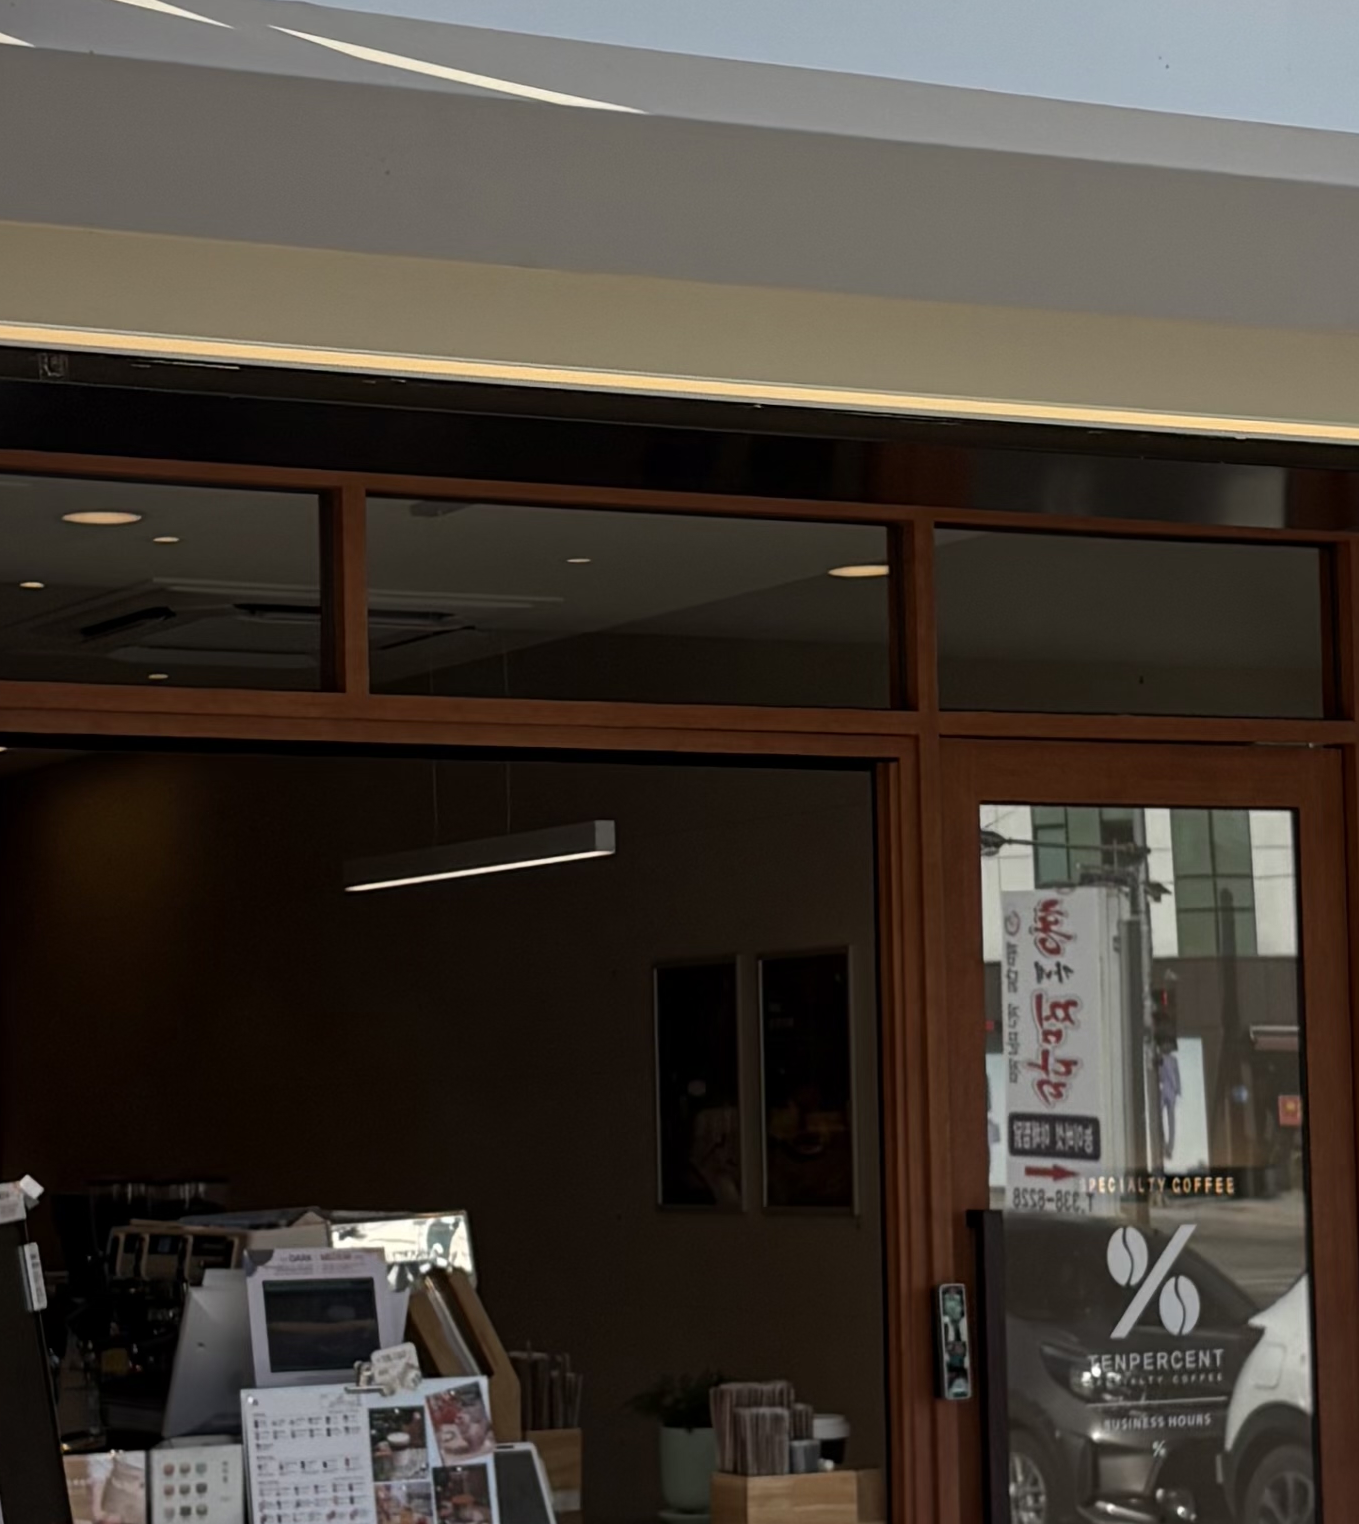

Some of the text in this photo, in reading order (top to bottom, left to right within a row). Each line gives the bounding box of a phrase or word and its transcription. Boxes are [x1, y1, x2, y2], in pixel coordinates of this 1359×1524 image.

[1171, 1176, 1236, 1195] COFFEE
[1089, 1348, 1225, 1372] TENPERCENT
[1167, 1412, 1212, 1428] HOURS
